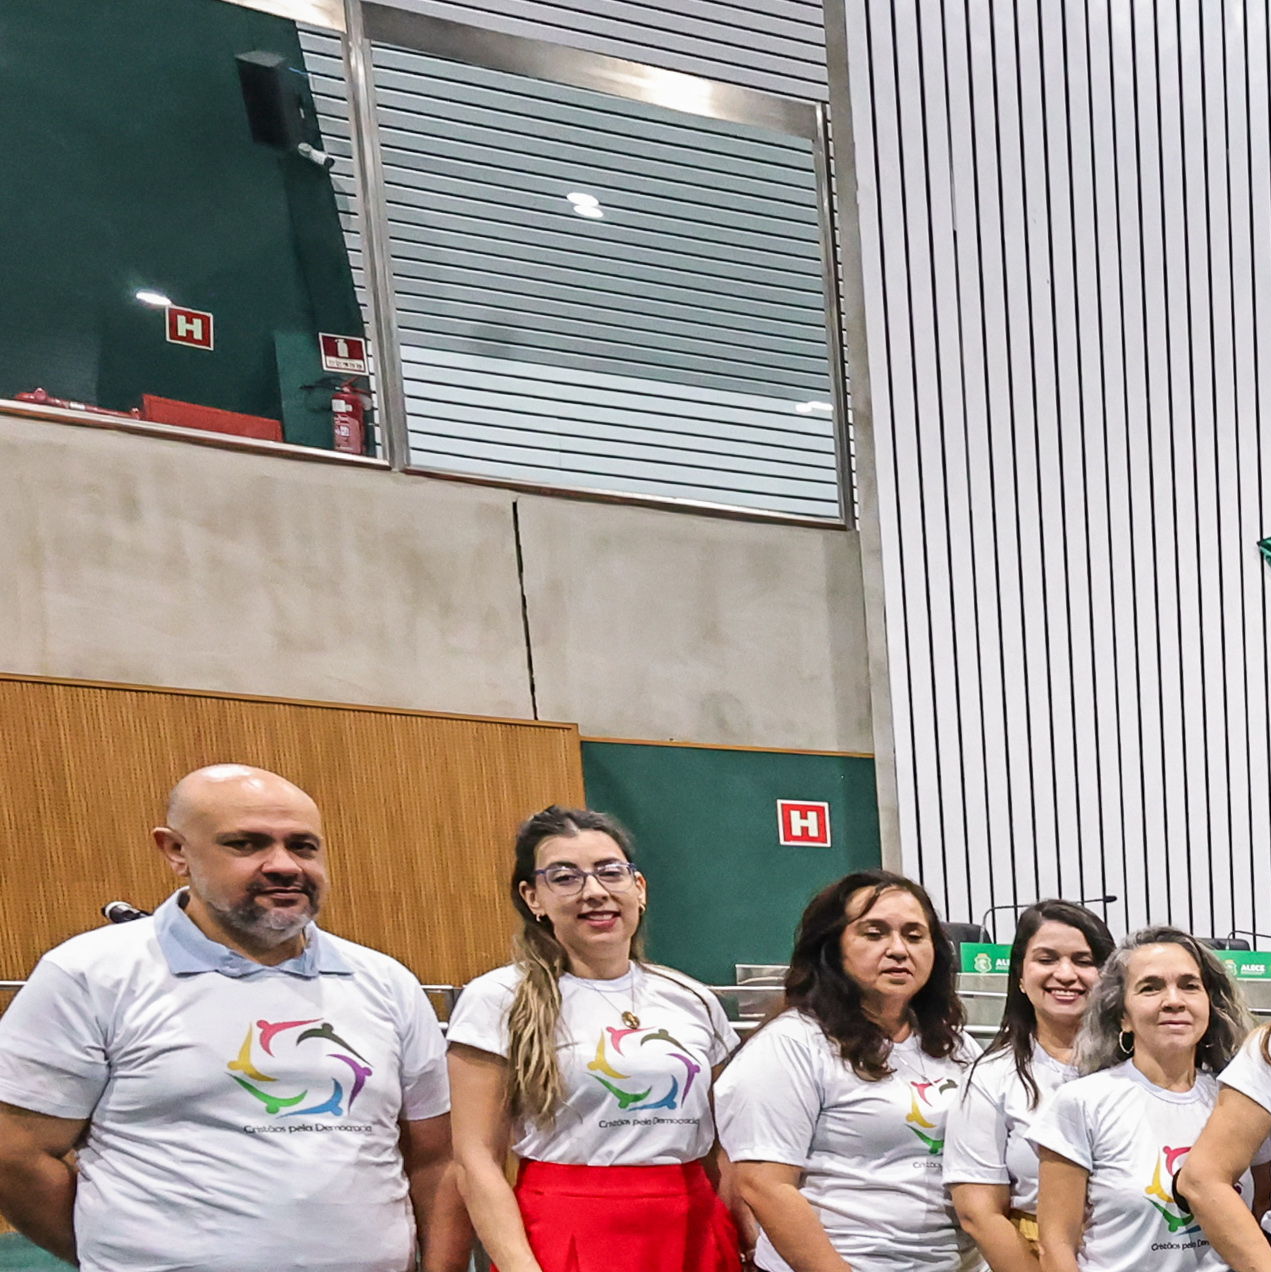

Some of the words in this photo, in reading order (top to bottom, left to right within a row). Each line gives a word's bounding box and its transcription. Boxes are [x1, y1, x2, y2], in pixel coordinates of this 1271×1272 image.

[176, 314, 203, 341] H
[789, 809, 819, 838] H
[1240, 964, 1266, 972] ALECE
[243, 1124, 286, 1133] Cristãos
[288, 1123, 313, 1134] pela
[315, 1124, 373, 1133] Democracia
[1151, 1241, 1180, 1251] Cristãos
[1182, 1241, 1196, 1250] pela
